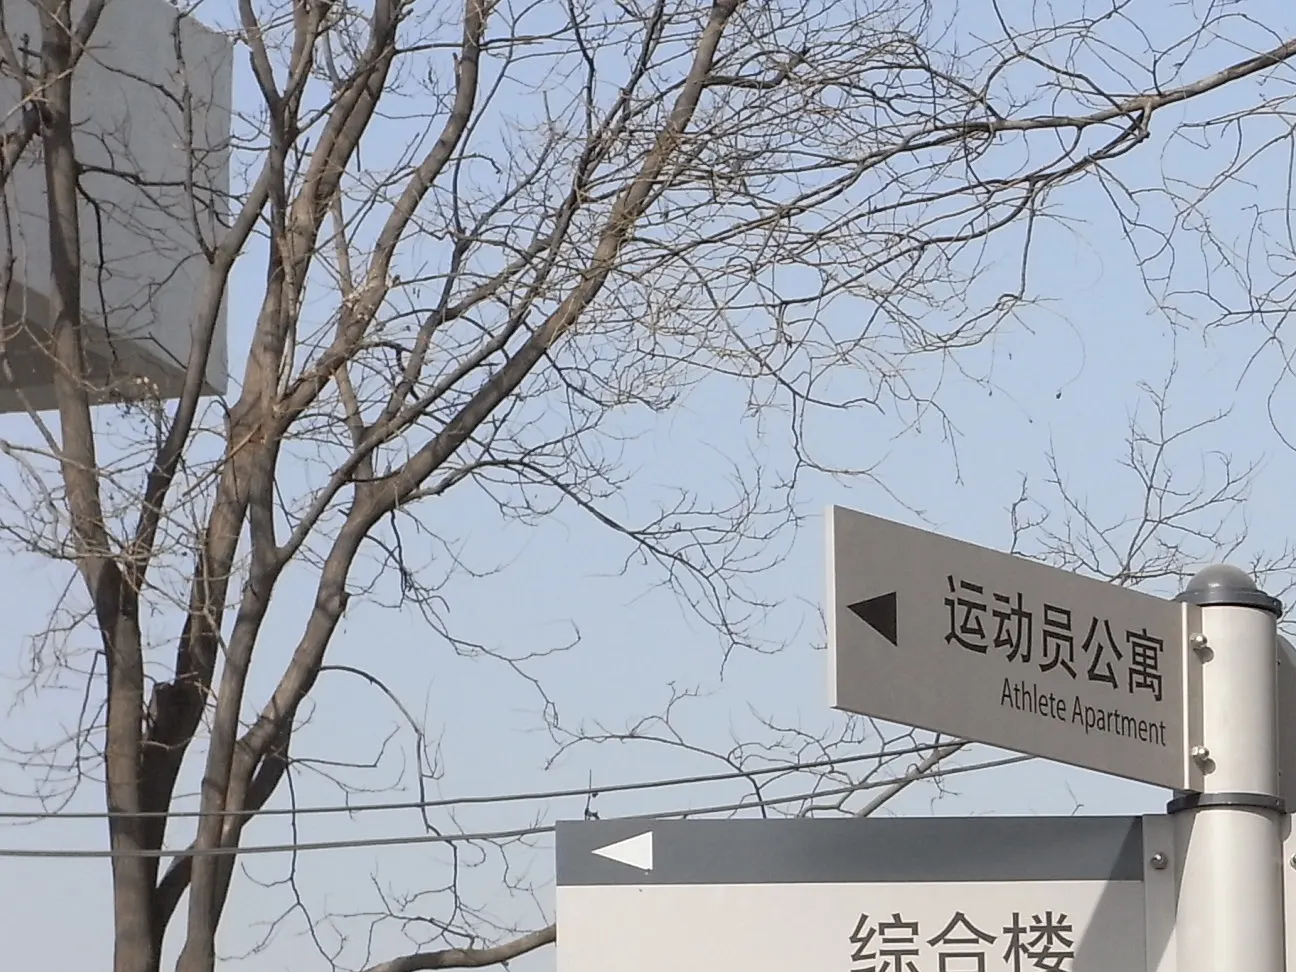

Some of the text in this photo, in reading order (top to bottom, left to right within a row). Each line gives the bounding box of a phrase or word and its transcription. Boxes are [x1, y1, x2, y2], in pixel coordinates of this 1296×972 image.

[944, 574, 1165, 702] 运动员公寓
[1000, 677, 1167, 747] Athlete Apartment
